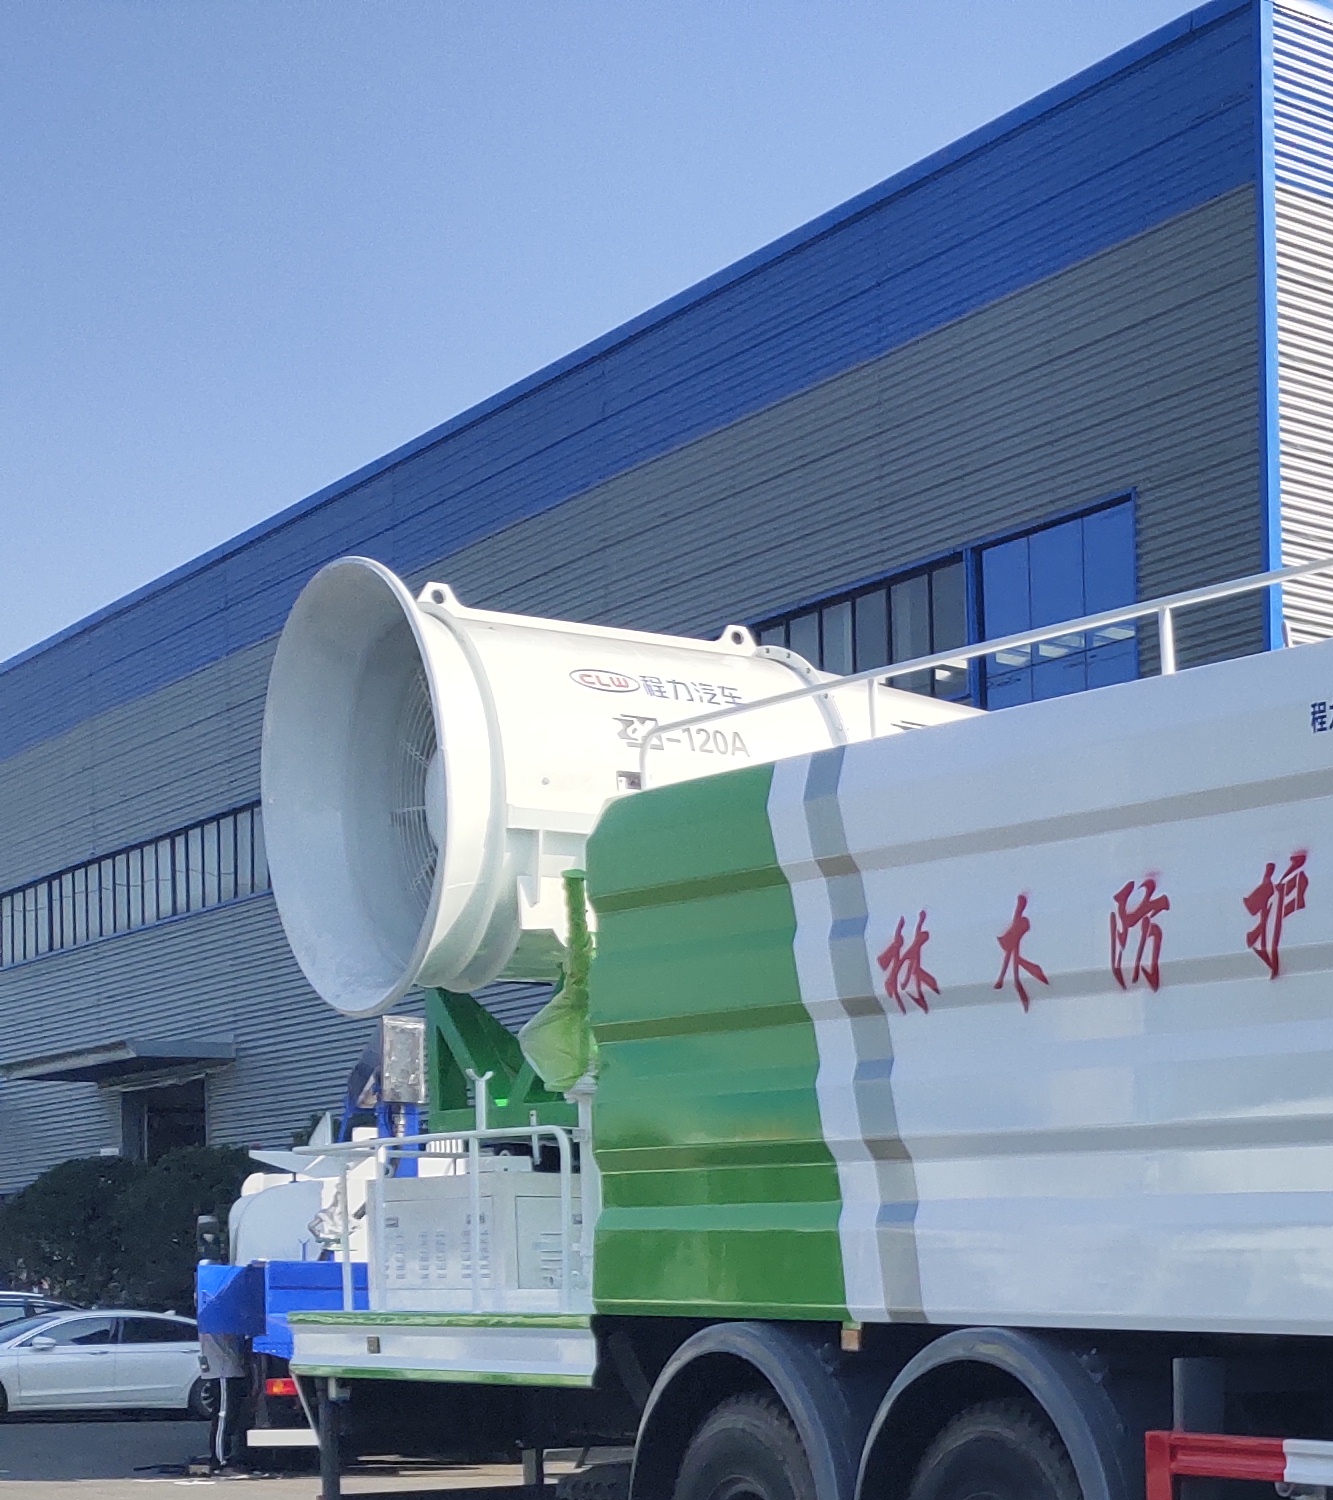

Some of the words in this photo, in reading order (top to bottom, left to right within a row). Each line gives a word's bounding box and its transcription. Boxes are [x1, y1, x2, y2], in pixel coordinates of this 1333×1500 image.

[578, 673, 630, 689] CLW
[639, 675, 745, 706] 程力汽车
